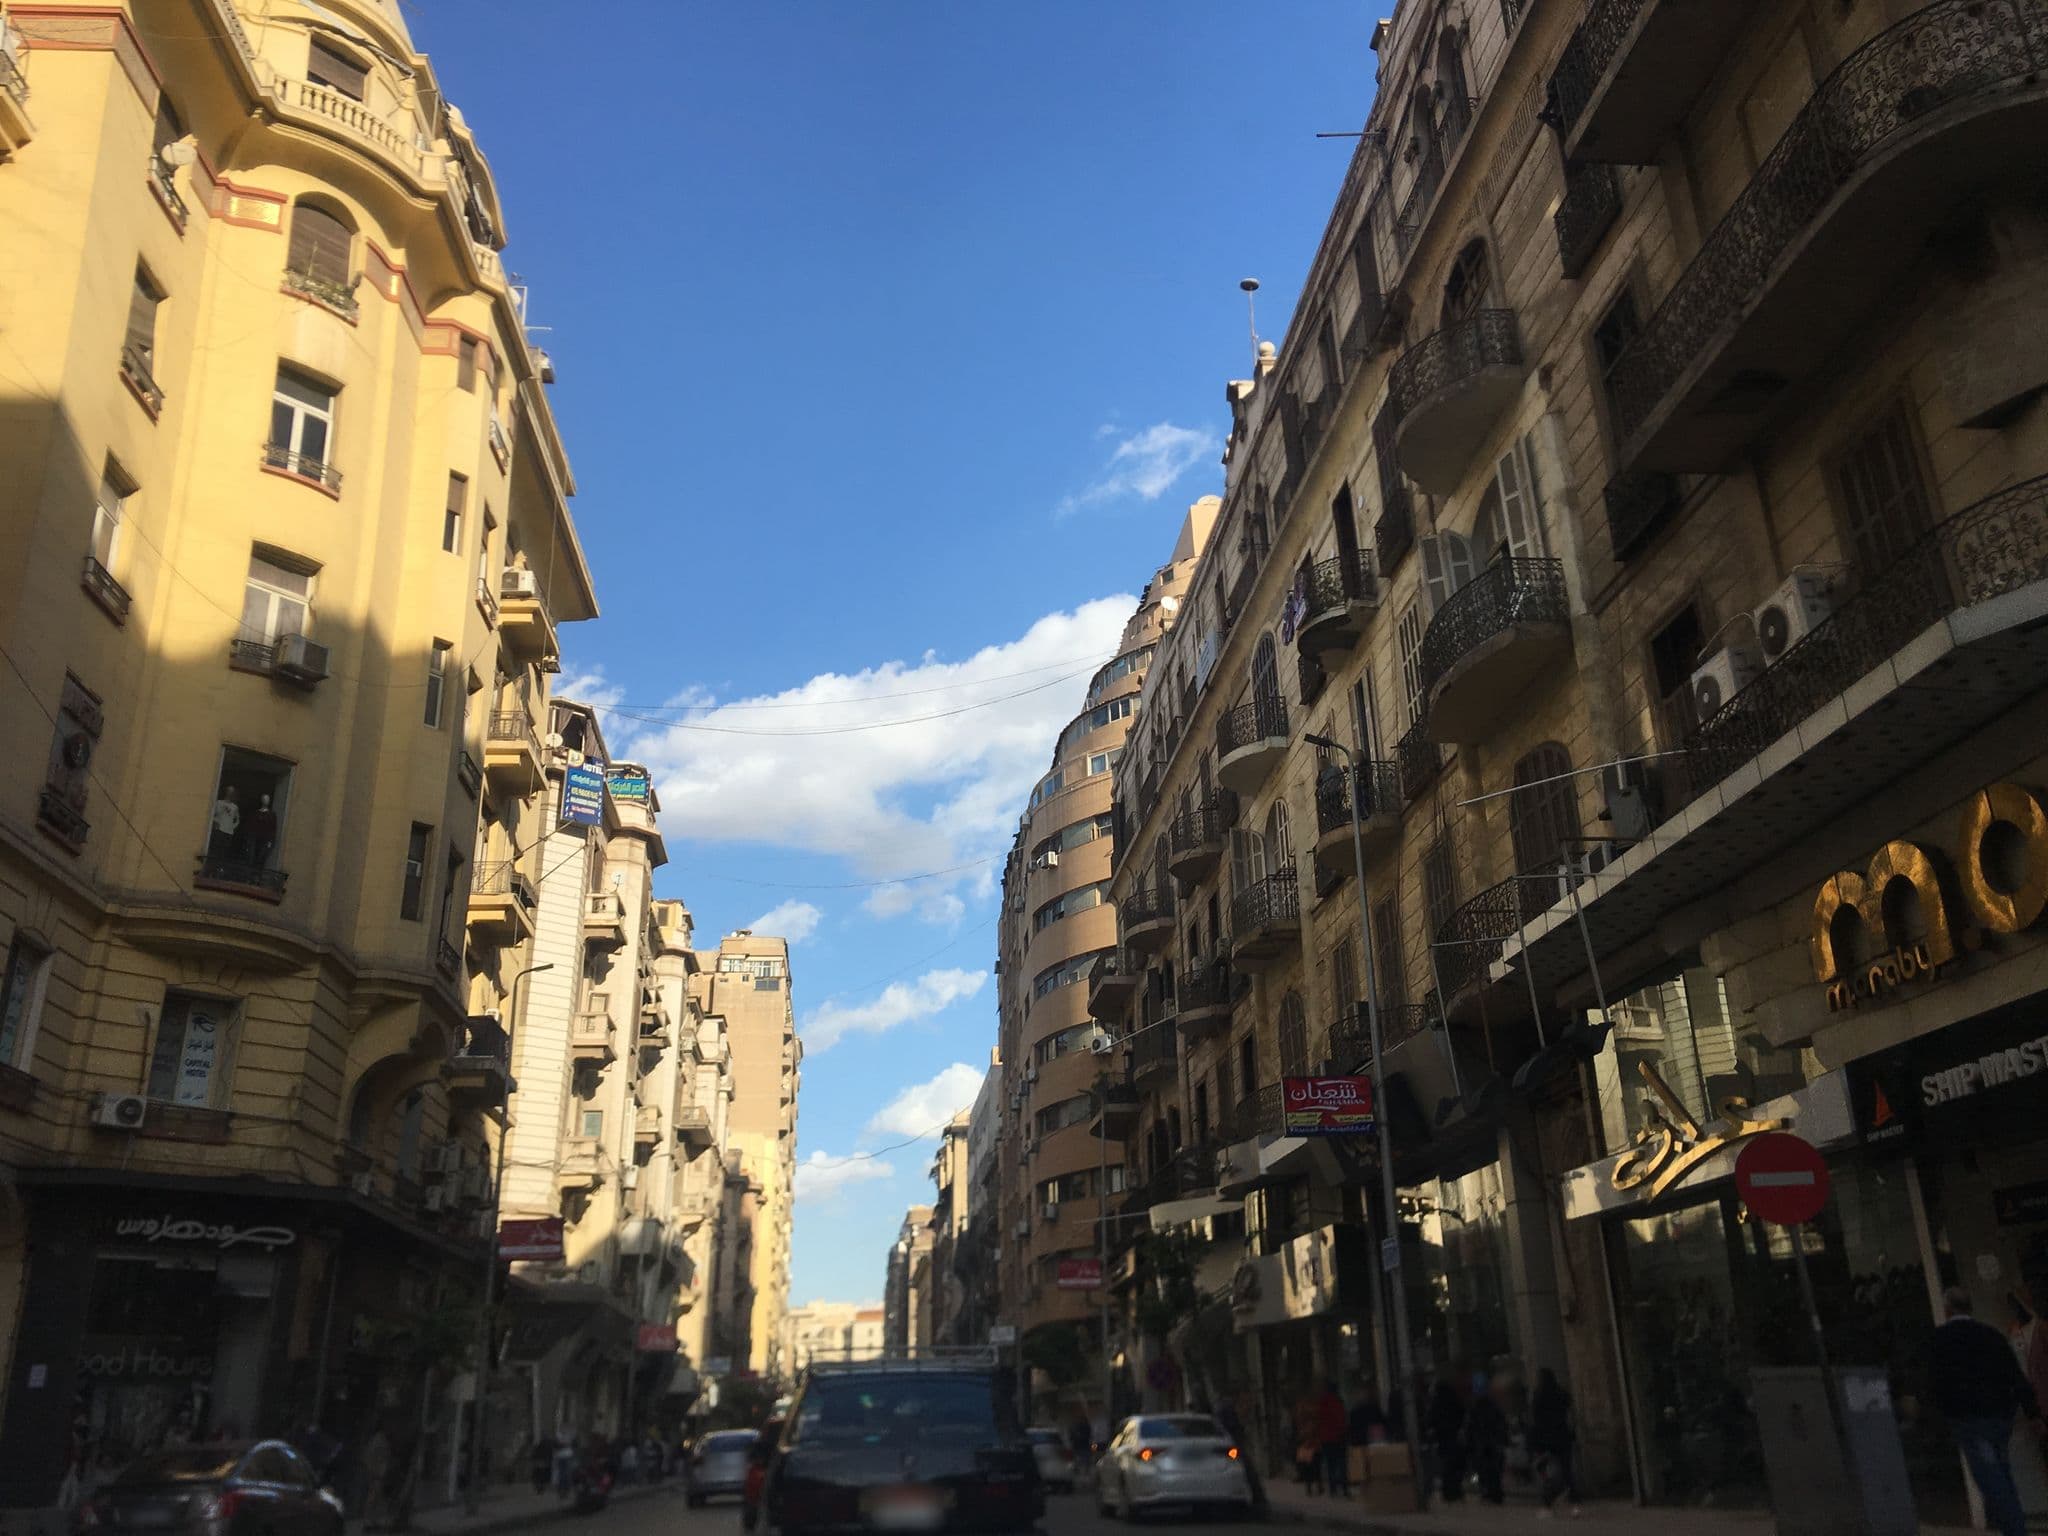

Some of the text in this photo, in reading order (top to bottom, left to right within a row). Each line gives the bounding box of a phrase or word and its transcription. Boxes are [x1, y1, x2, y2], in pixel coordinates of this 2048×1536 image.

[583, 763, 604, 774] HOTEL
[1291, 1081, 1357, 1103] شعبان
[1922, 1062, 1980, 1106] SHIP
